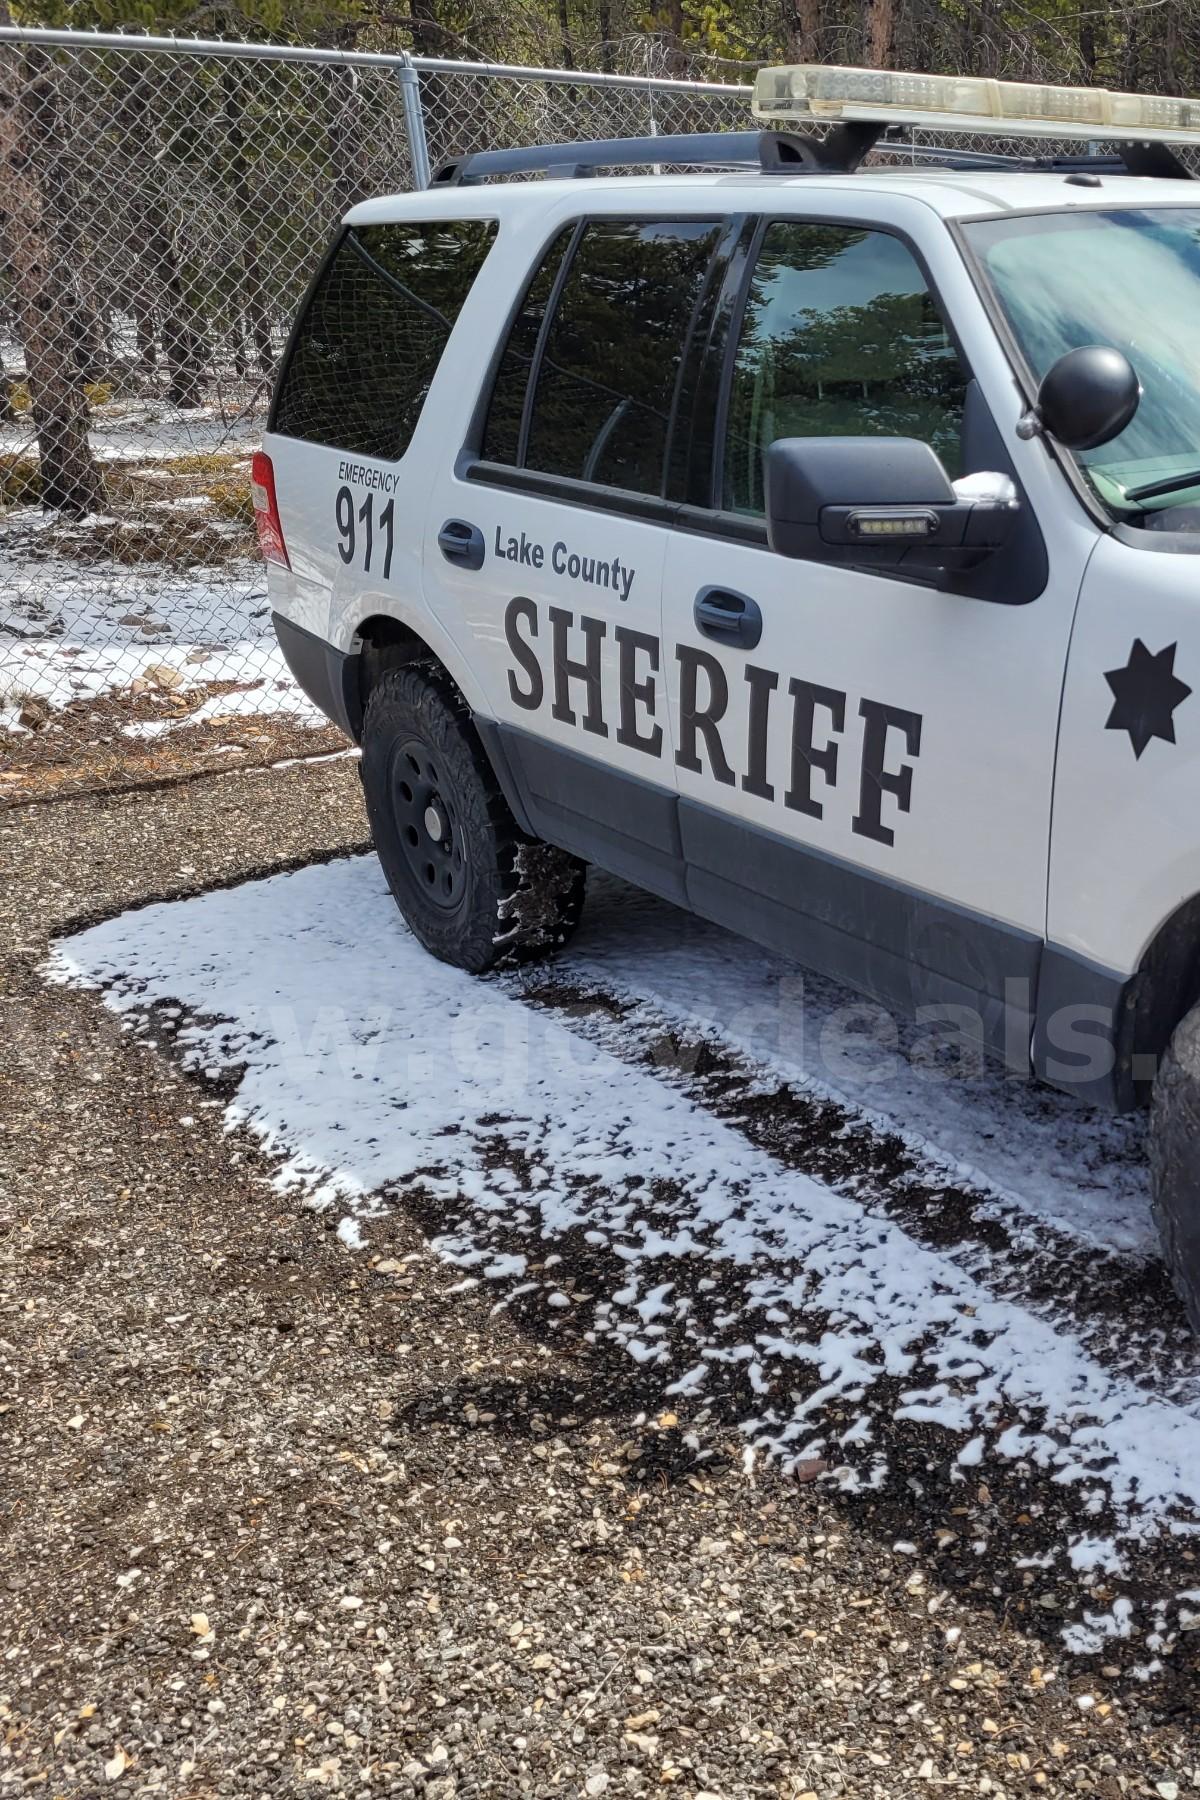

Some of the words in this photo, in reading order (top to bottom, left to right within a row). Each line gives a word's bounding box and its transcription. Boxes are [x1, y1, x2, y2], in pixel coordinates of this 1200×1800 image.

[338, 461, 400, 494] EMERGENCY
[335, 485, 394, 580] 911
[494, 525, 544, 569] Lake
[551, 541, 636, 602] County
[504, 595, 923, 848] SHERIFF
